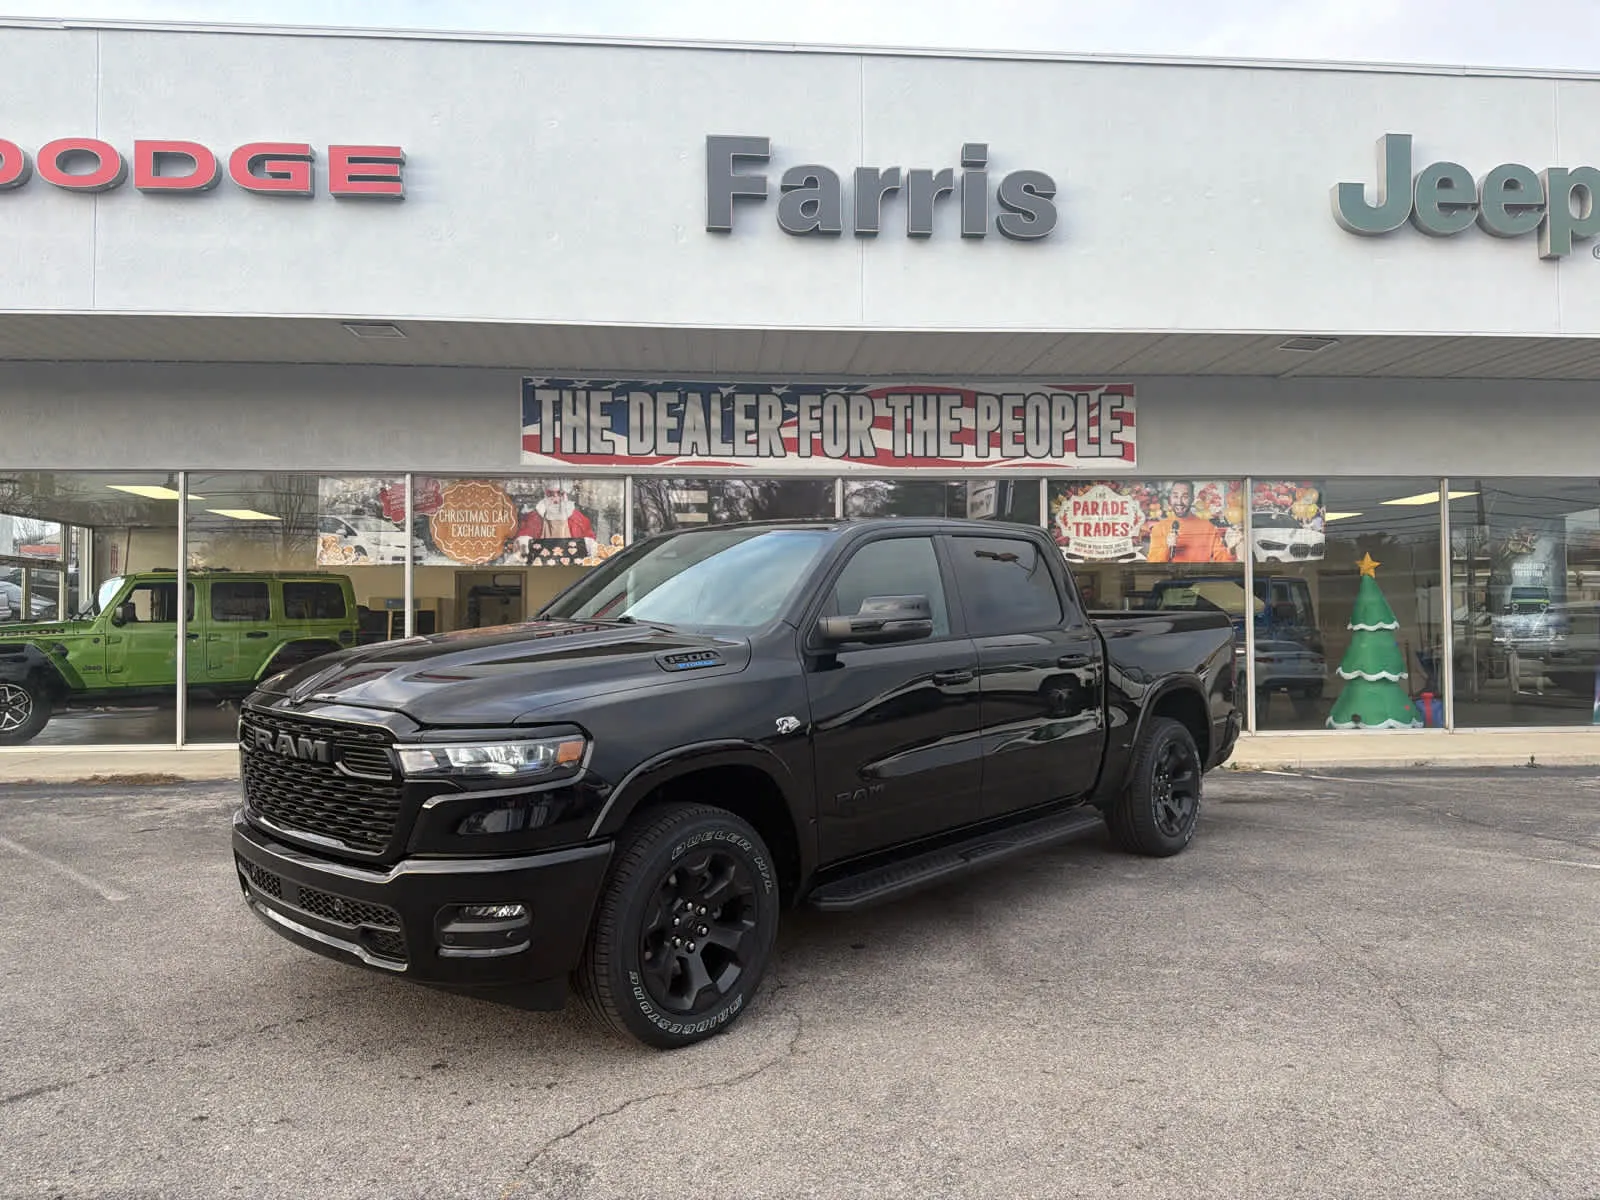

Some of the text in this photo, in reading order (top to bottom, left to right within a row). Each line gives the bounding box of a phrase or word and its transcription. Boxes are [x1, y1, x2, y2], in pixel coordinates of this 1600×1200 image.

[0, 137, 406, 200] ODGE
[705, 134, 1058, 241] Farris
[1330, 132, 1600, 261] Jeep
[533, 387, 1125, 458] THE DEALER FOR THE PEOPLE
[438, 509, 510, 523] CHRISTMAS CAR
[1073, 500, 1129, 516] PARADE
[451, 524, 498, 538] EXCHANGE
[1072, 522, 1130, 537] TRADES
[254, 726, 333, 763] RAM
[671, 830, 752, 861] DUELER
[628, 969, 744, 1035] BRIDGESTONE
